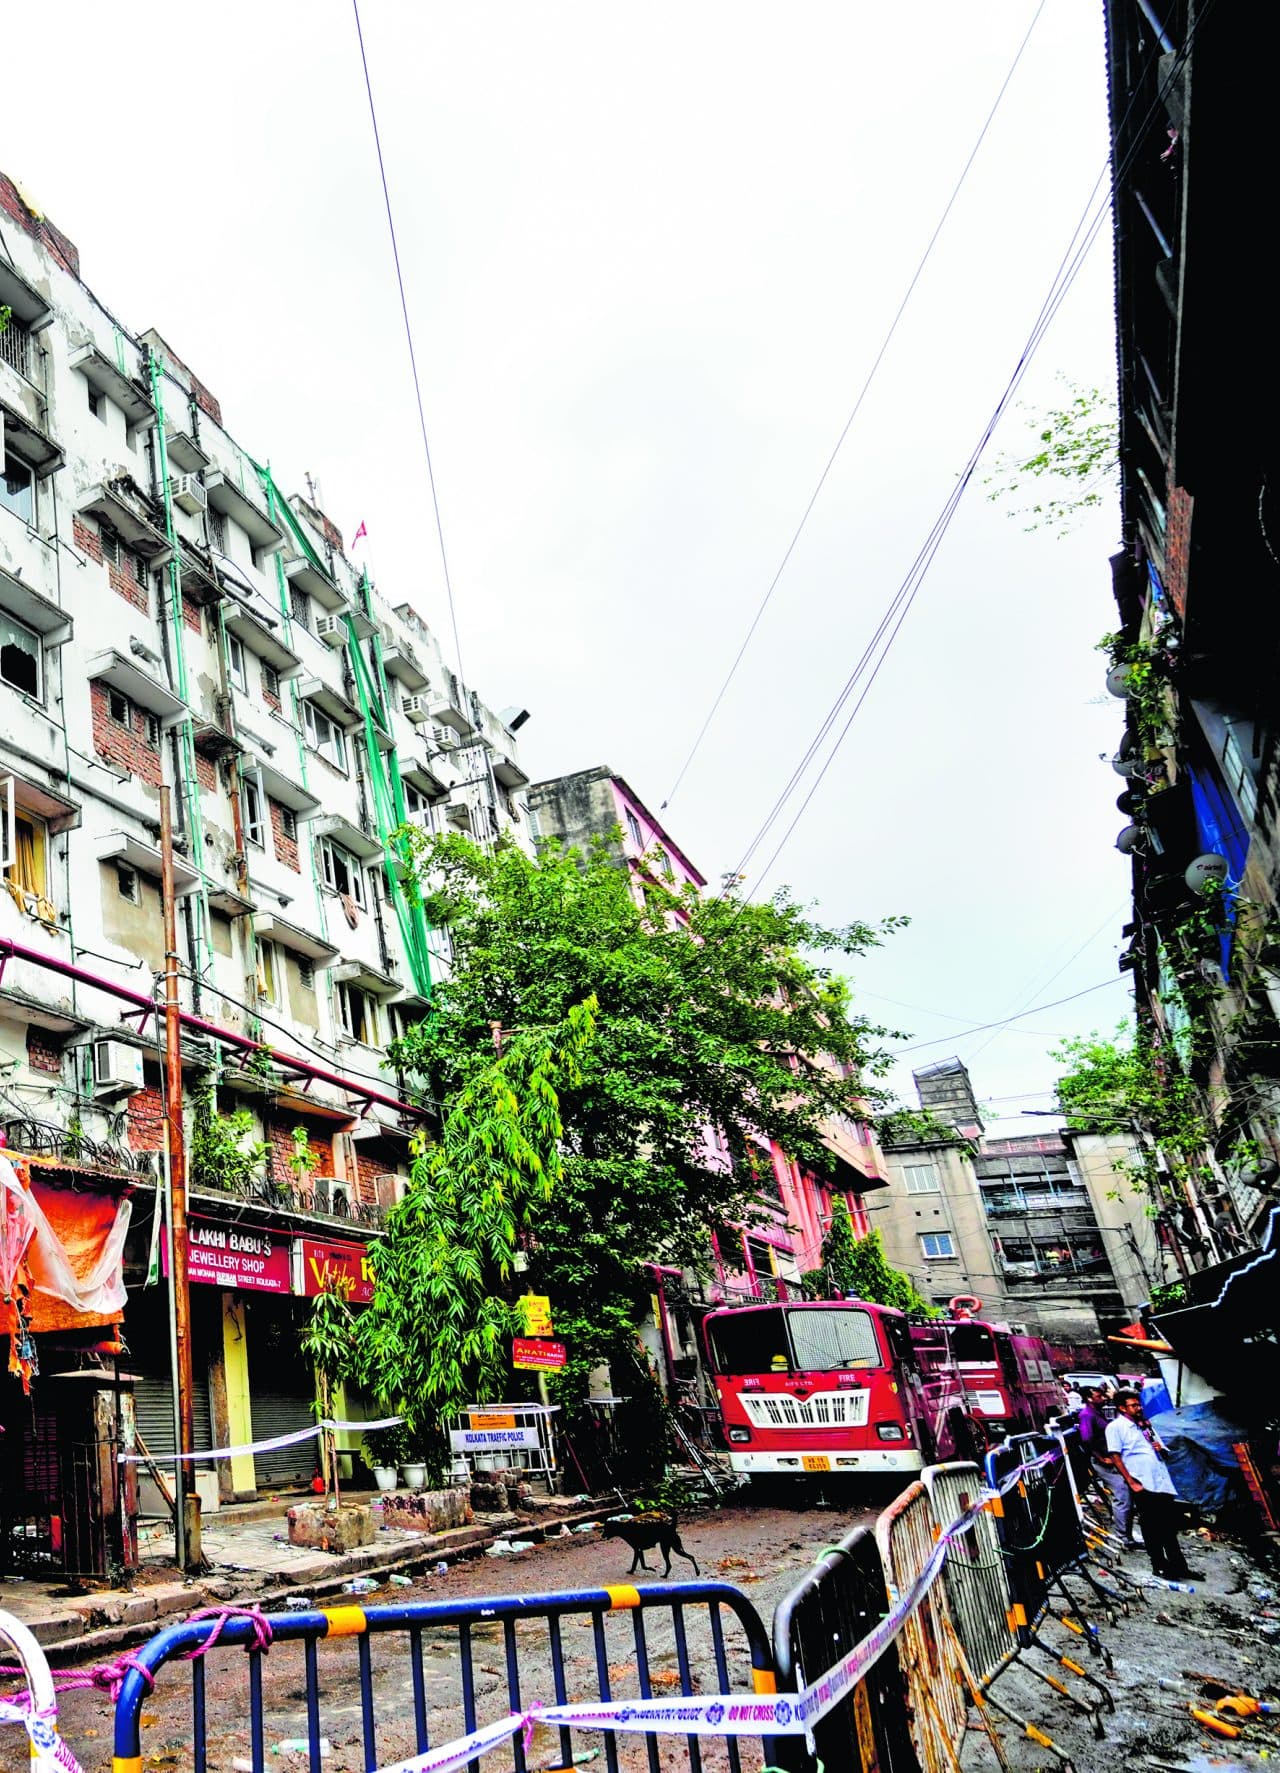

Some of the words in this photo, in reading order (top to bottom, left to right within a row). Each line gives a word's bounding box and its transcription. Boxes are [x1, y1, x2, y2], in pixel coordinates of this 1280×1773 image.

[188, 1227, 226, 1249] LAKHI
[229, 1233, 273, 1258] BABU'S
[189, 1249, 240, 1270] JEWELLERY
[241, 1258, 265, 1273] SHOP
[838, 1374, 856, 1382] FIRE
[465, 1433, 487, 1443] KOLKATA
[487, 1431, 507, 1443] TRAFFIC
[507, 1431, 524, 1441] POLICE
[728, 1705, 738, 1721] DO
[739, 1705, 753, 1720] NOT
[753, 1704, 775, 1720] CROSS
